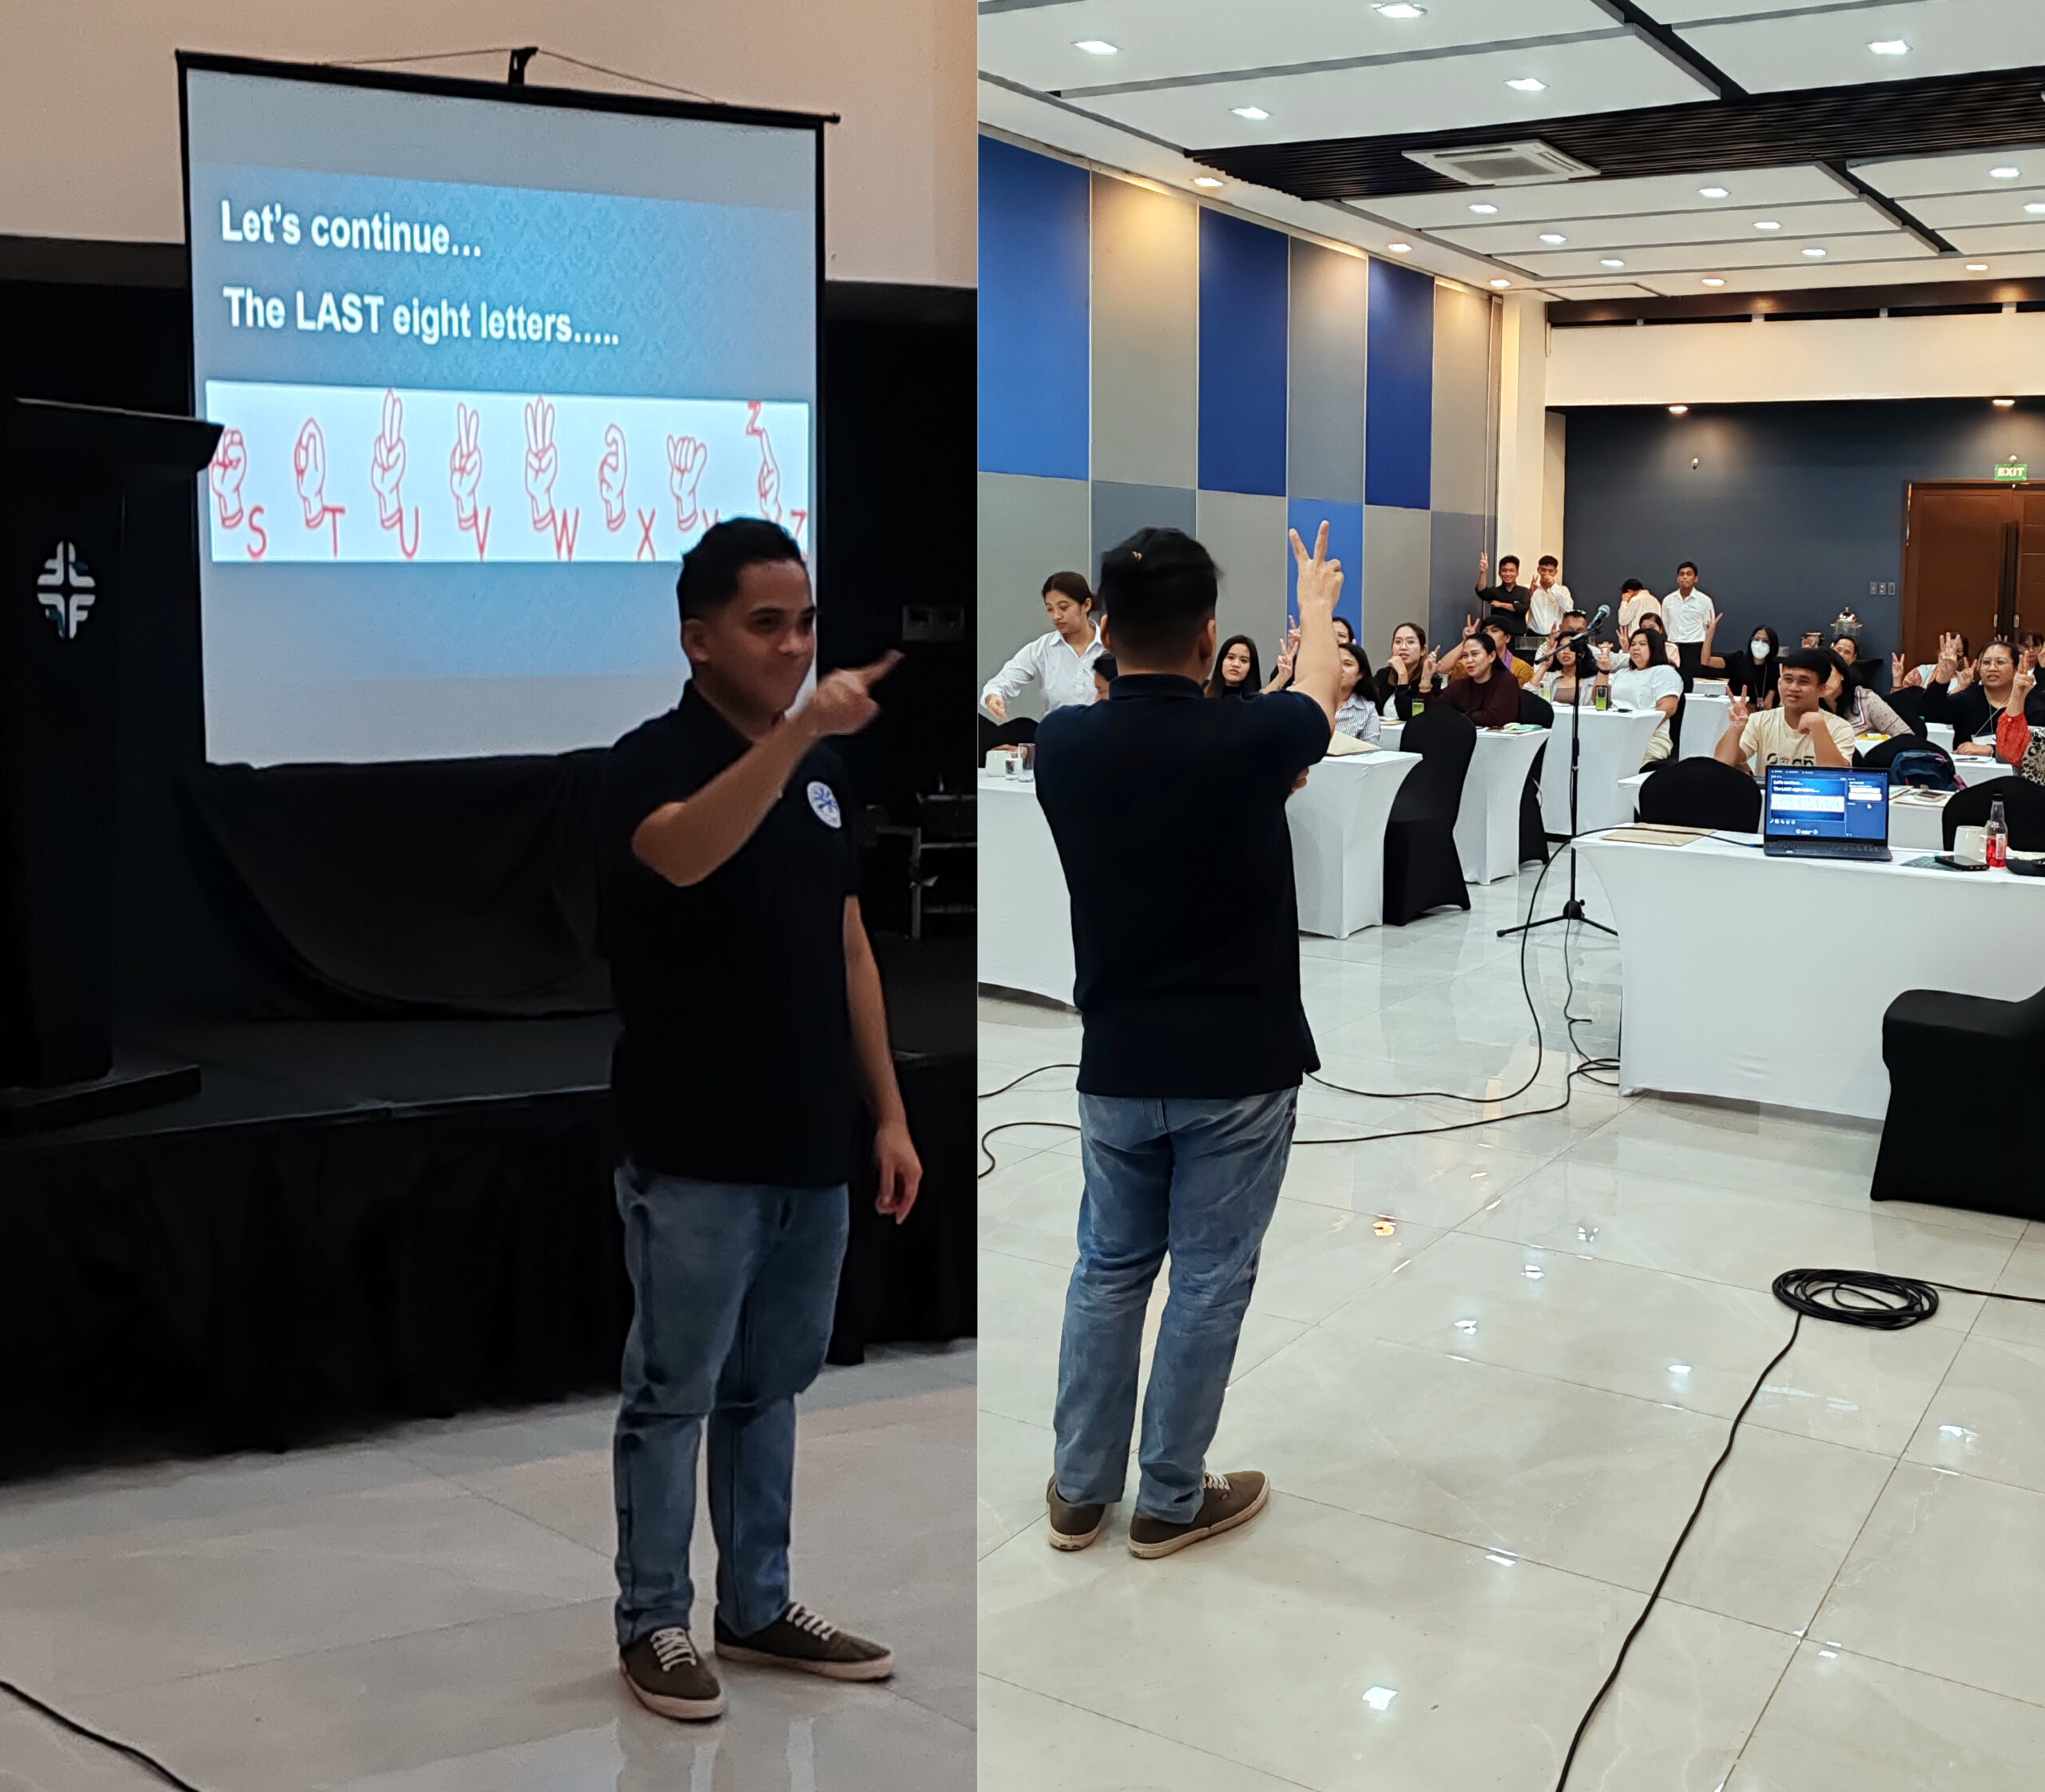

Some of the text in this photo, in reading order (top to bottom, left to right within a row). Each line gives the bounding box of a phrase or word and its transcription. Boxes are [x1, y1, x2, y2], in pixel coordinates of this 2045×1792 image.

[221, 200, 300, 244] Let's
[223, 287, 285, 328] The
[296, 291, 384, 333] LAST
[393, 299, 471, 344] eight
[1998, 467, 2025, 477] EXIT
[247, 503, 267, 561] S
[322, 504, 346, 558] T
[399, 506, 419, 561] U
[473, 506, 491, 562] V
[549, 507, 580, 562] W
[636, 508, 657, 562] X
